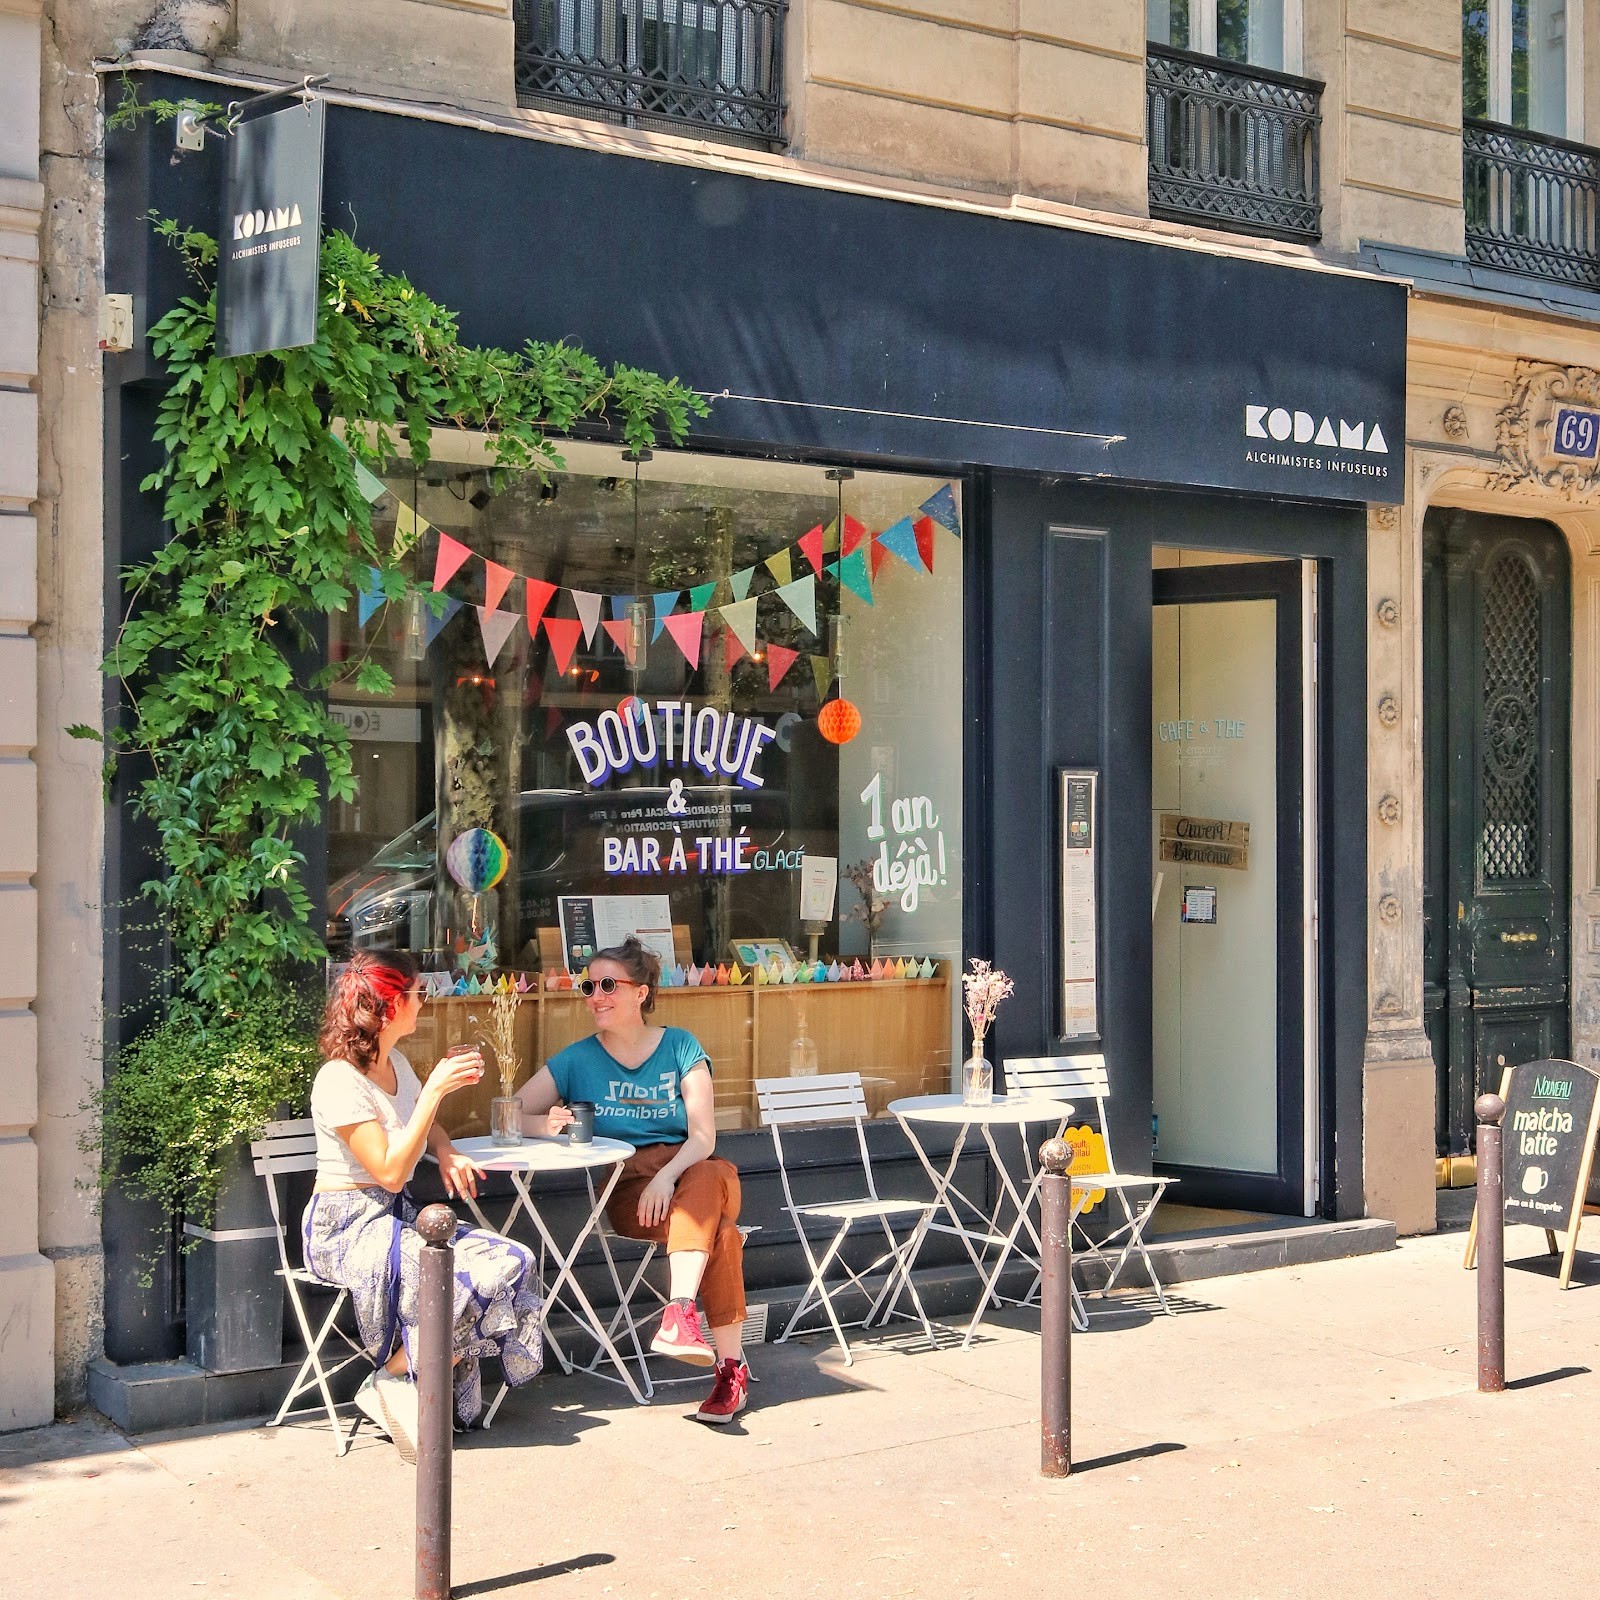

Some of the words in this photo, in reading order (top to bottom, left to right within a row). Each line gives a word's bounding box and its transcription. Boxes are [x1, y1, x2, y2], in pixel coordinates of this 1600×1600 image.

[233, 203, 302, 240] KODAMA
[232, 243, 268, 260] ALCHIMISTES
[269, 235, 301, 252] INFUSEURS
[1246, 404, 1389, 454] KODAMA
[1561, 415, 1593, 452] 69
[1245, 451, 1322, 470] ALCHIMISTES
[1326, 460, 1389, 478] INFUSEURS
[566, 700, 777, 789] BOUTIQUE
[666, 778, 687, 816] &
[860, 772, 884, 838] 1
[891, 795, 939, 833] an
[603, 837, 661, 875] BAR
[667, 825, 688, 873] À
[695, 825, 751, 874] THÉ
[753, 844, 805, 871] GLACÉ
[1513, 1106, 1573, 1134] matcha
[1519, 1131, 1558, 1156] latte
